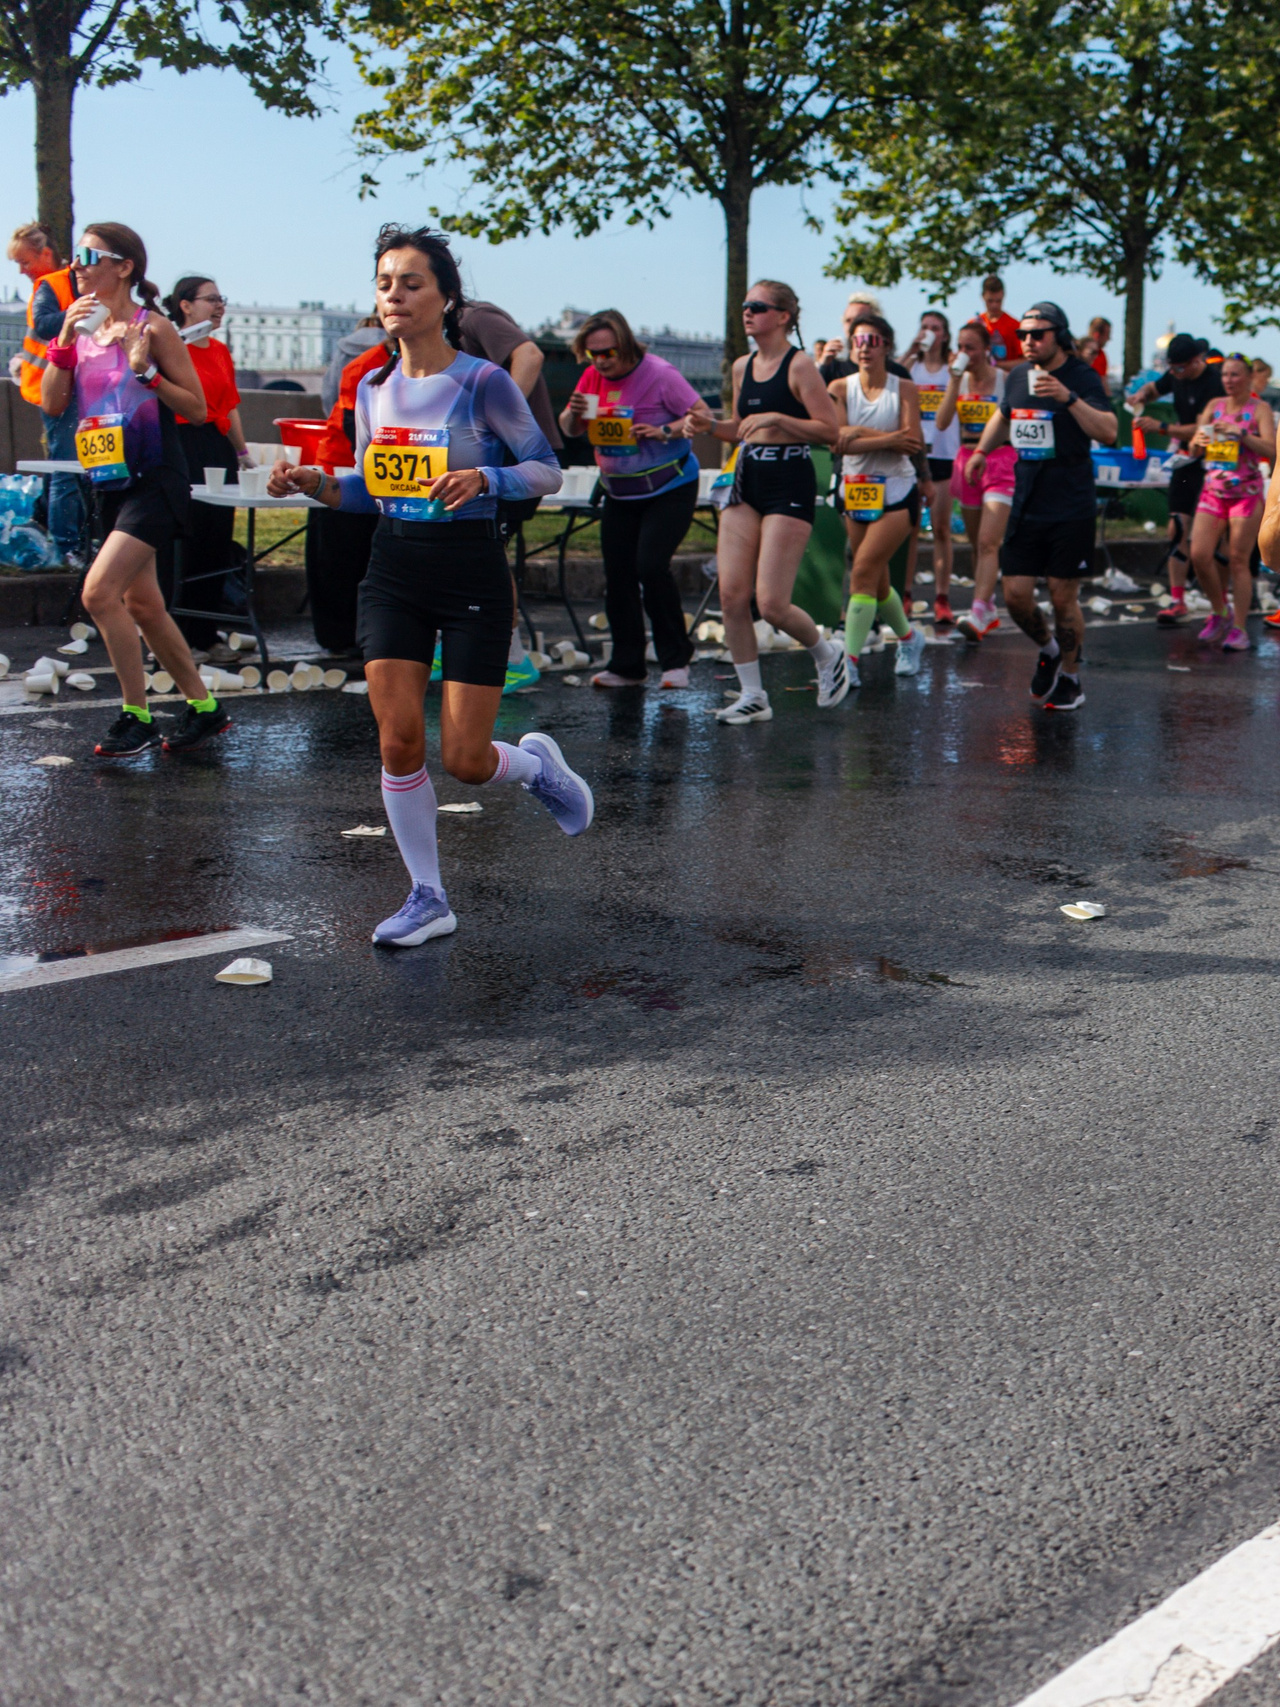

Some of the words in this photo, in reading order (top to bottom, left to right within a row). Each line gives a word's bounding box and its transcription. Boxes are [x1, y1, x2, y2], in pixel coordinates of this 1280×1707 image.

[961, 404, 990, 416] 5601
[598, 421, 623, 437] 300
[1016, 424, 1046, 439] 6431
[81, 433, 116, 457] 3638
[373, 453, 432, 481] 5371
[390, 483, 422, 492] ОКСАНА
[848, 487, 878, 501] 4753
